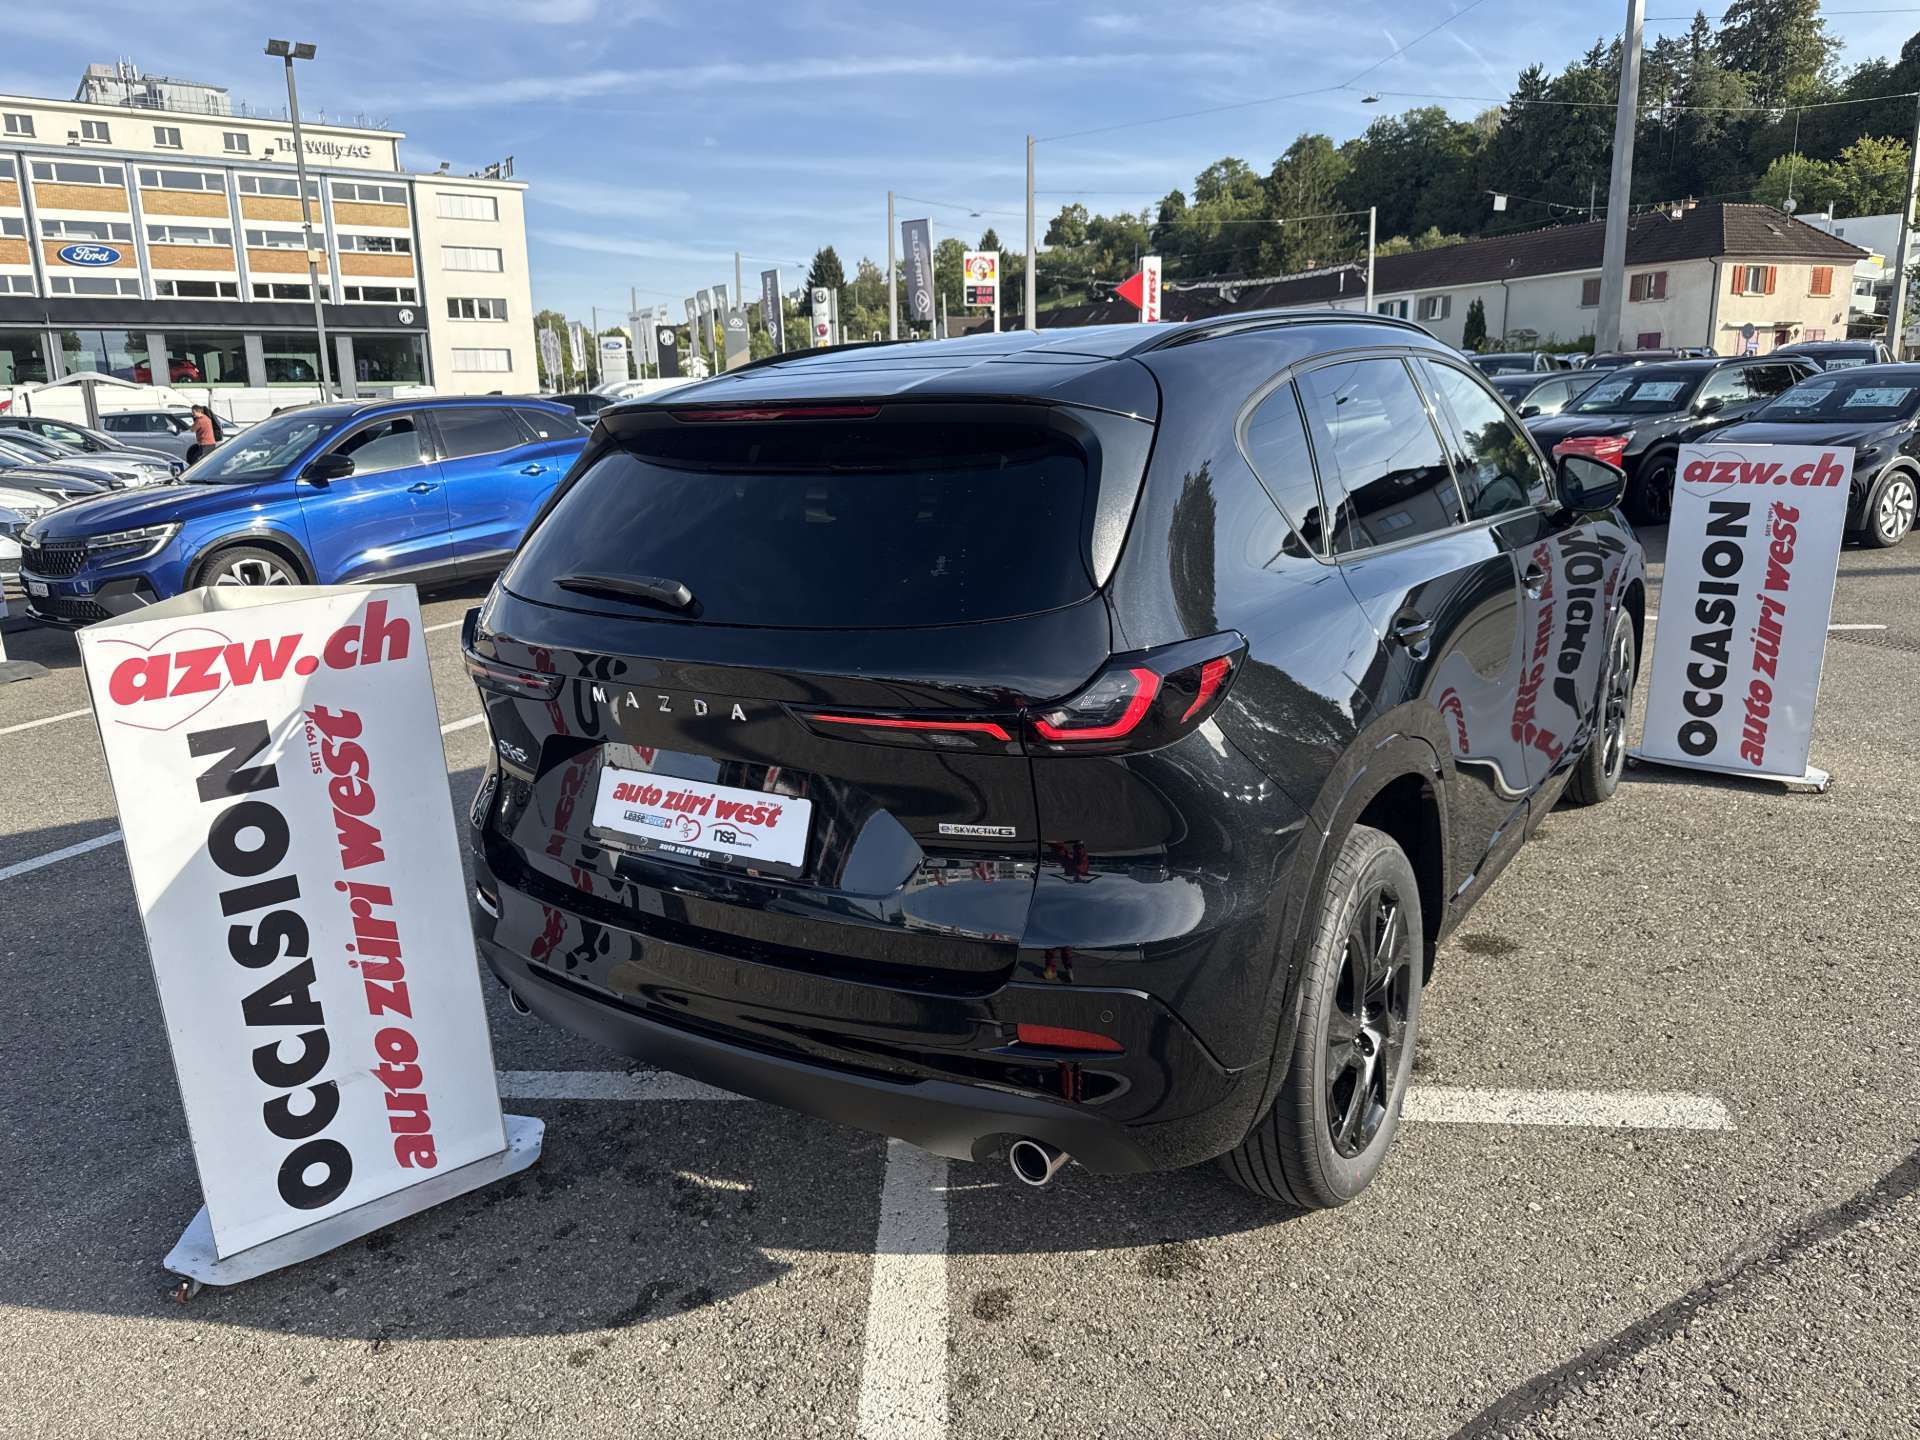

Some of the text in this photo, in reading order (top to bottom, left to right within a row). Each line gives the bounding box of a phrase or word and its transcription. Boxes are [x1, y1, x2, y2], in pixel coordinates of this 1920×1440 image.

[304, 140, 343, 159] Willy
[1671, 209, 1682, 217] 48
[72, 246, 109, 262] Ford
[1683, 453, 1844, 486] azw.ch
[1677, 501, 1751, 756] OCCASION
[1740, 500, 1800, 766] auto züri west
[109, 600, 410, 706] azw.ch
[592, 686, 746, 721] MAZDA
[304, 719, 323, 775] SEIT 1991
[612, 782, 783, 828] auto züri west
[659, 842, 675, 852] auto
[713, 829, 736, 844] nsa
[304, 704, 438, 1169] auto züri west
[187, 719, 353, 1210] OCCASION
